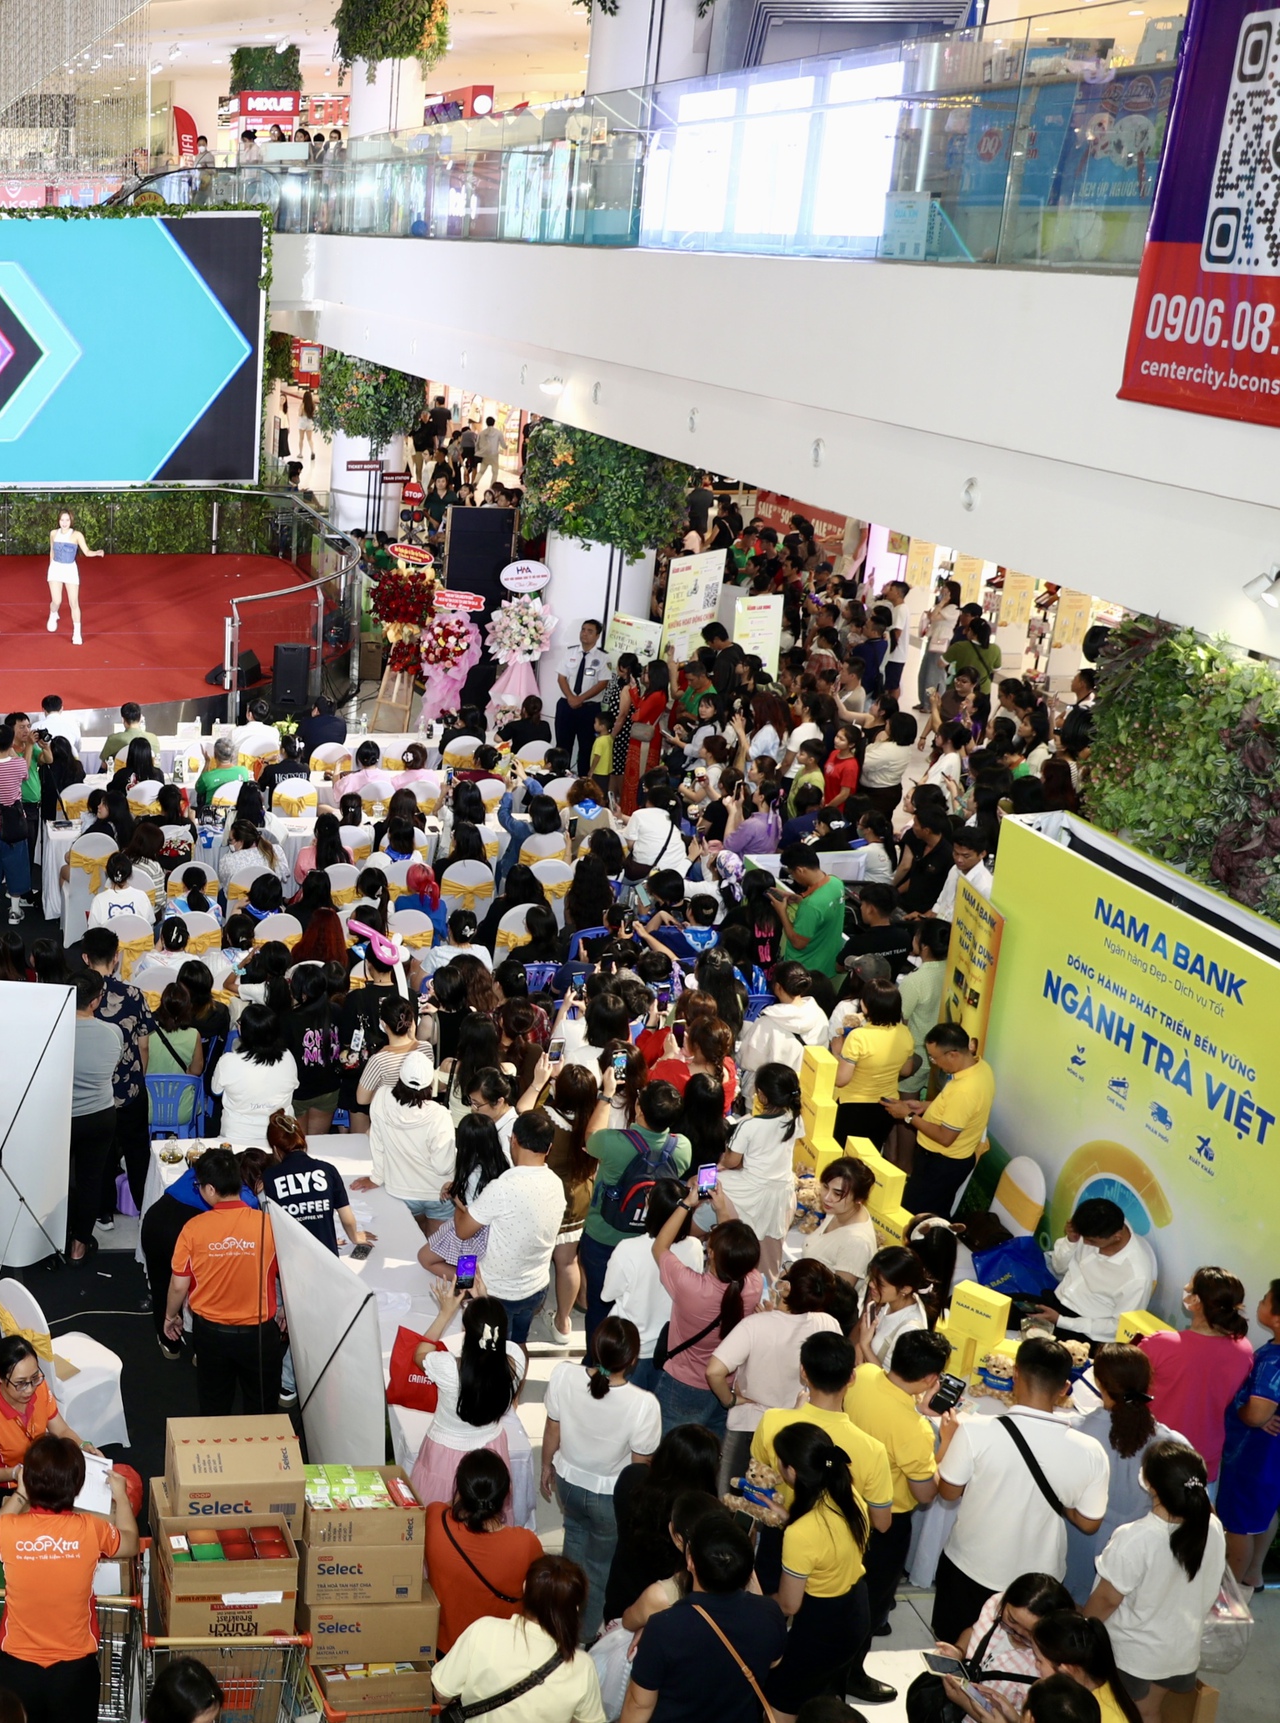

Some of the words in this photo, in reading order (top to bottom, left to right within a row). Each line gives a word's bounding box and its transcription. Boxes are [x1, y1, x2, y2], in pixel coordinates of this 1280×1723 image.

[248, 97, 294, 111] MIXUE
[980, 135, 998, 153] DQ
[1145, 293, 1279, 355] 0906.08.
[1140, 360, 1280, 395] centercity.bcons
[404, 490, 422, 499] STOP
[758, 501, 773, 519] SALE
[811, 519, 827, 538] SALE
[962, 887, 976, 909] NAM
[979, 906, 997, 930] BANK
[1094, 897, 1150, 948] NAM
[1150, 932, 1167, 960] A
[1172, 941, 1247, 1006] BANK
[1104, 937, 1126, 958] Ngân
[1127, 950, 1148, 973] hàng
[1150, 965, 1167, 983] Đẹp
[1174, 979, 1194, 999] Dịch
[1196, 993, 1208, 1009] vụ
[1209, 999, 1225, 1018] Tốt
[1067, 953, 1095, 980] ĐỒNG
[1097, 972, 1127, 1000] HÀNH
[1130, 992, 1158, 1019] PHÁT
[1160, 1011, 1191, 1042] TRIỂN
[1220, 1049, 1256, 1082] VỮNG
[1043, 969, 1135, 1054] NGÀNH
[1141, 1031, 1193, 1097] TRÀ
[1205, 1072, 1276, 1146] VIỆT
[1145, 1123, 1158, 1136] PHÂN
[1188, 1154, 1201, 1166] XUẤT
[1201, 1163, 1215, 1177] KHẨU
[273, 1169, 328, 1199] ELYS
[890, 1226, 901, 1240] BANK
[956, 1300, 970, 1310] NAM
[975, 1309, 992, 1319] BANK
[281, 1447, 291, 1470] Select
[188, 1500, 252, 1515] Select
[406, 1518, 414, 1541] Select
[317, 1563, 363, 1575] Select
[216, 1615, 253, 1624] Breakfast
[318, 1622, 361, 1634] Select
